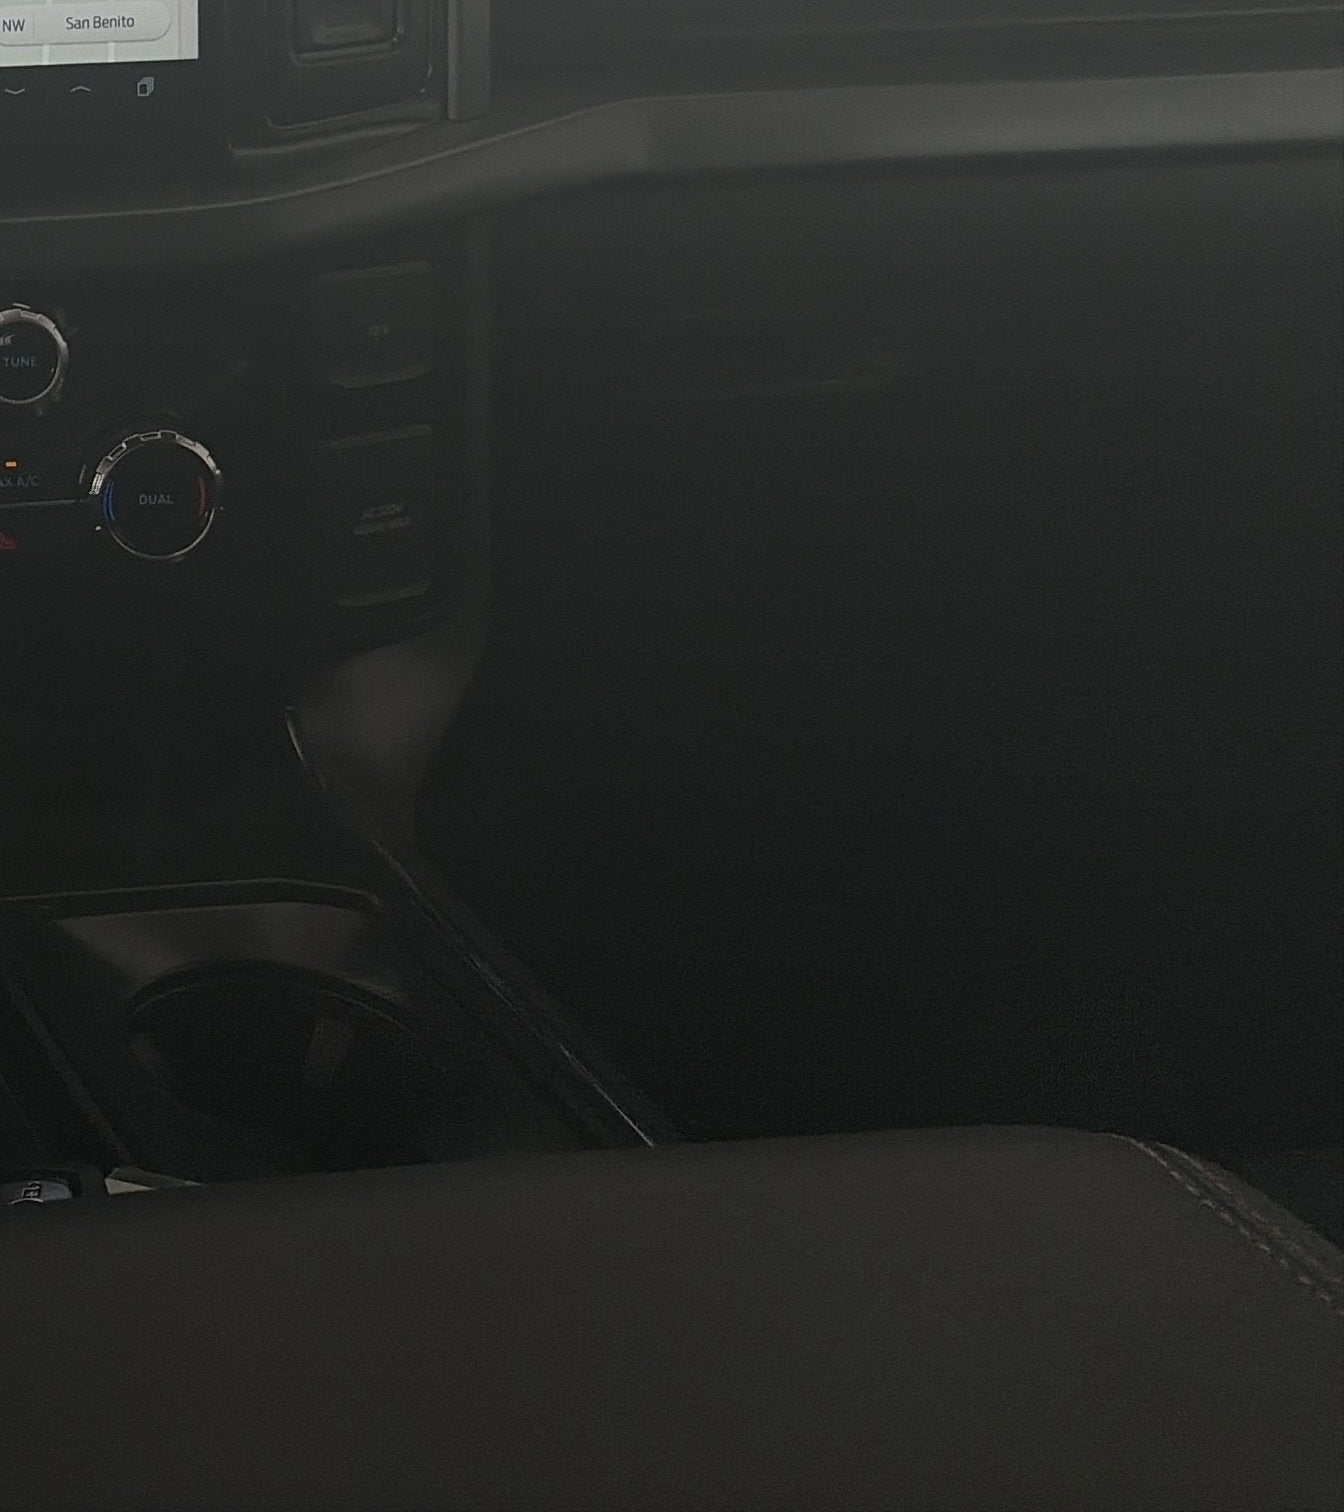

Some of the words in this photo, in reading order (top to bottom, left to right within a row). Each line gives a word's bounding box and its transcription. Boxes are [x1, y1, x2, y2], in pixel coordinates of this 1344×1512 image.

[2, 19, 26, 33] NW
[65, 16, 91, 31] San
[93, 15, 135, 30] Benito
[139, 493, 174, 506] DUAL
